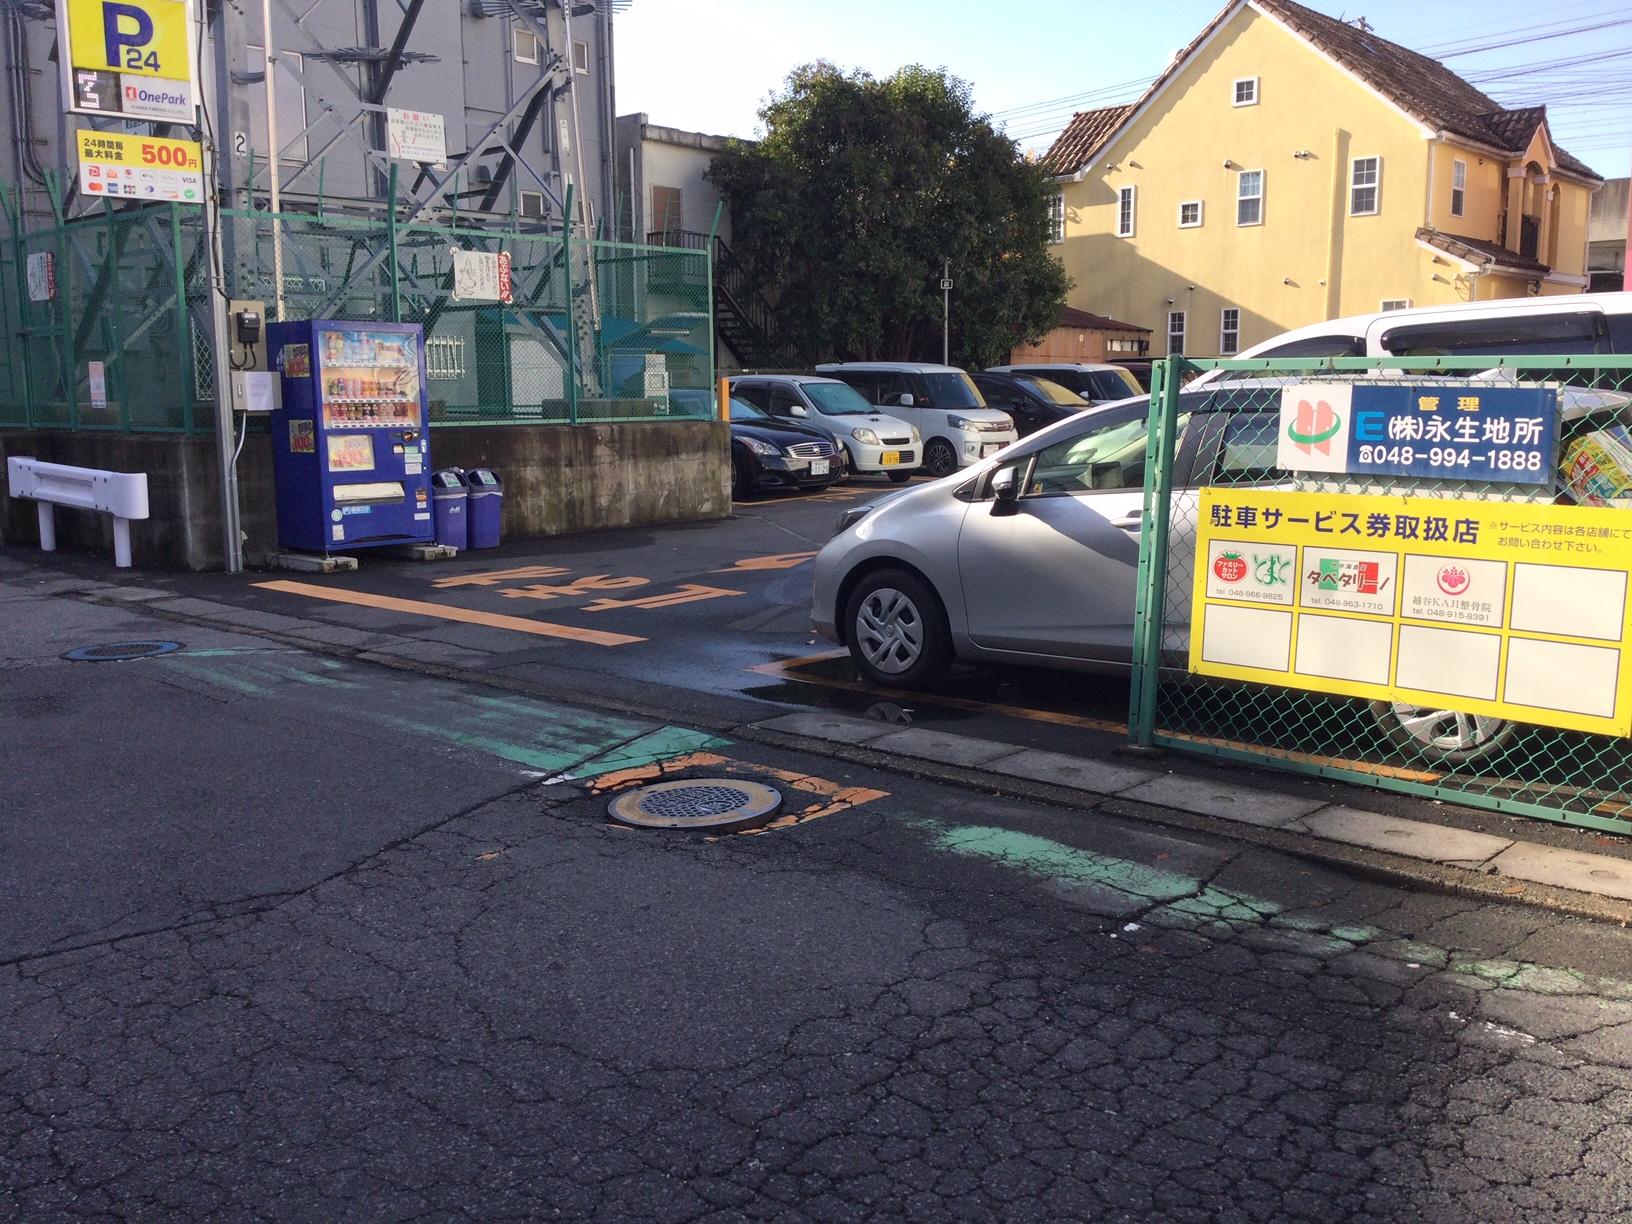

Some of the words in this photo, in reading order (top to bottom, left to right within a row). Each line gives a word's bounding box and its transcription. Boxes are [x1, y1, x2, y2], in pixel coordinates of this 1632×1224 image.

[103, 2, 154, 67] P
[126, 48, 161, 73] 24
[139, 89, 187, 106] OnePark
[84, 148, 124, 161] 最大料金
[1417, 395, 1480, 412] 管理
[1387, 414, 1544, 446] (株)永生地所
[1210, 504, 1480, 545] 駐車サービス券取扱店
[1497, 536, 1602, 553] お問い合わせ下さい。
[1216, 560, 1244, 568] ファミリー
[1307, 570, 1391, 591] タベタリーノ
[1324, 598, 1384, 611] 048-963-1710
[1426, 608, 1490, 622] 048-915-8391
